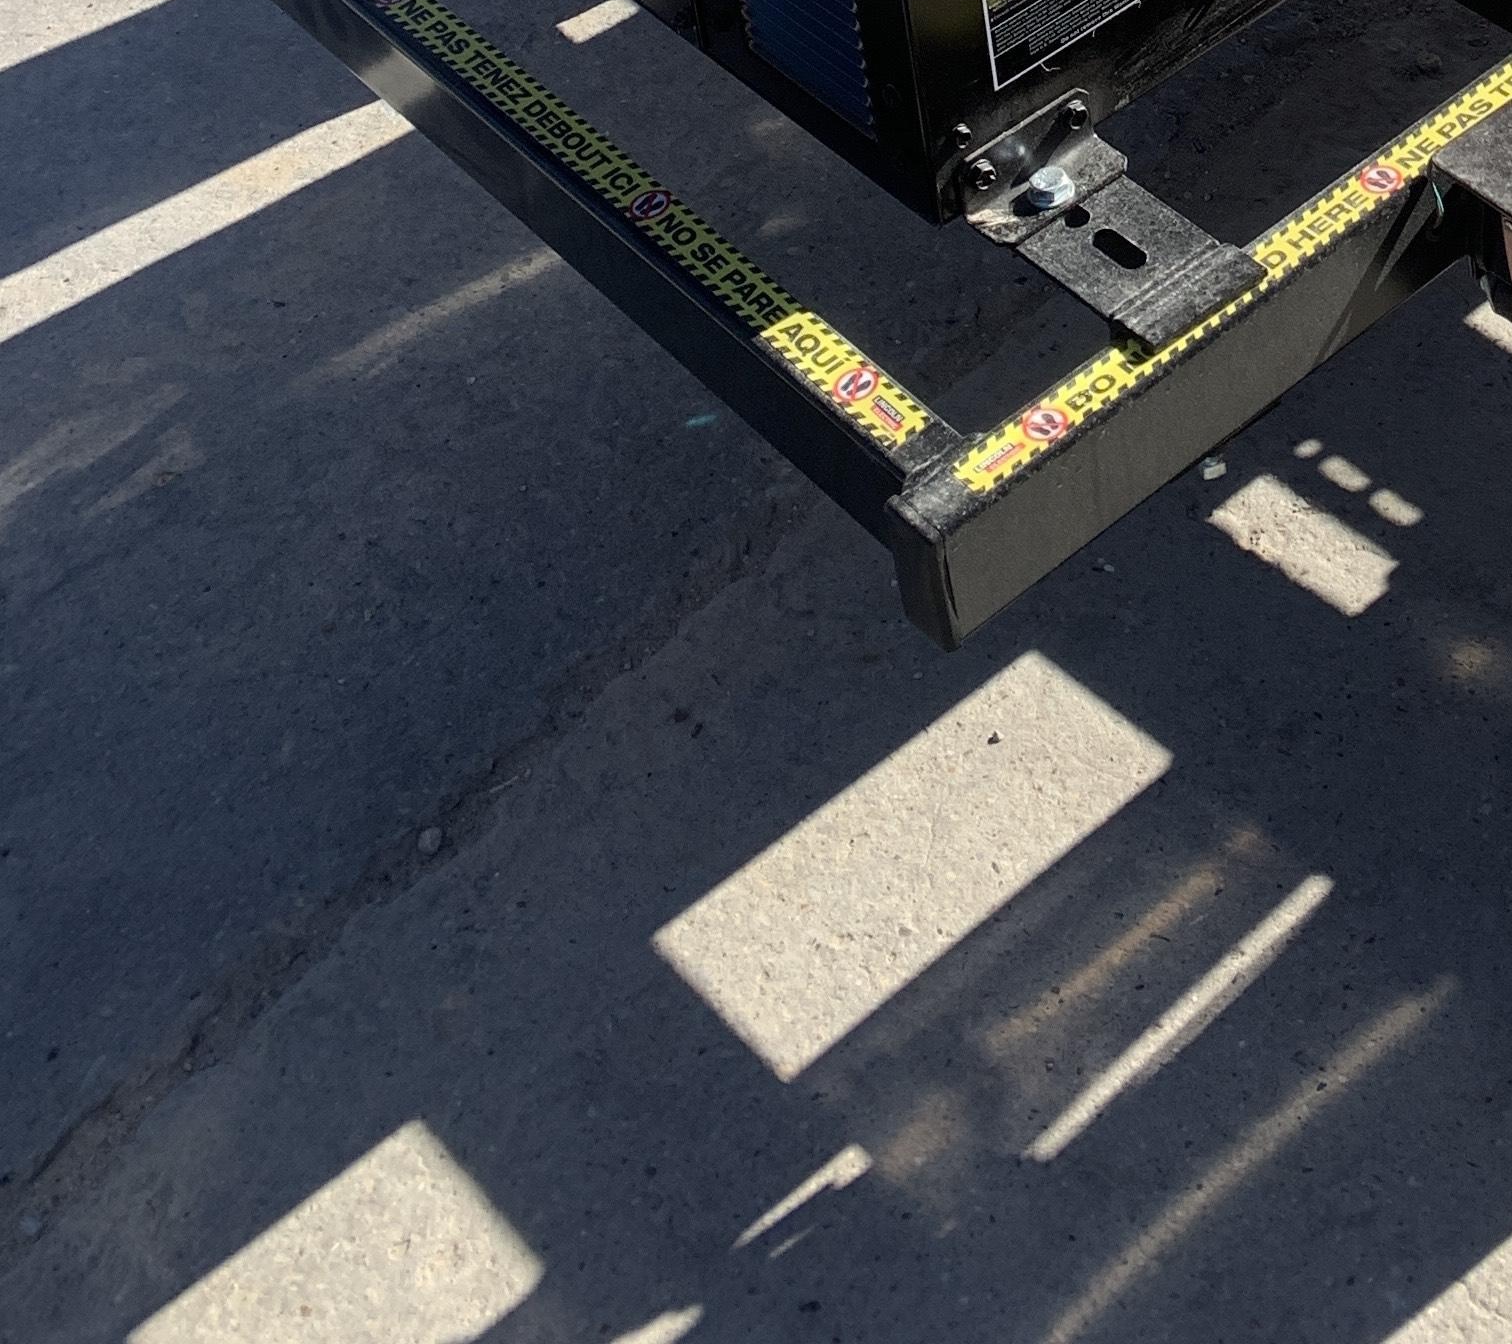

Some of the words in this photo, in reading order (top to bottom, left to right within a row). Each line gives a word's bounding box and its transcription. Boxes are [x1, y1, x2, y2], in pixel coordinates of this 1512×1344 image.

[399, 0, 433, 28] NE
[425, 20, 470, 55] PAS
[465, 49, 532, 105] TENEZ
[522, 99, 615, 170] DEBOUT
[602, 167, 640, 196] ICI
[656, 213, 697, 245] NO
[690, 242, 729, 275] SE
[720, 268, 789, 326] PARE
[778, 322, 852, 375] AQUÍ
[1287, 189, 1370, 251] HERE
[1397, 136, 1441, 171] NE
[1436, 98, 1494, 143] PAS
[873, 396, 905, 423] LINCOLN
[974, 442, 1013, 473] LINCOLN
